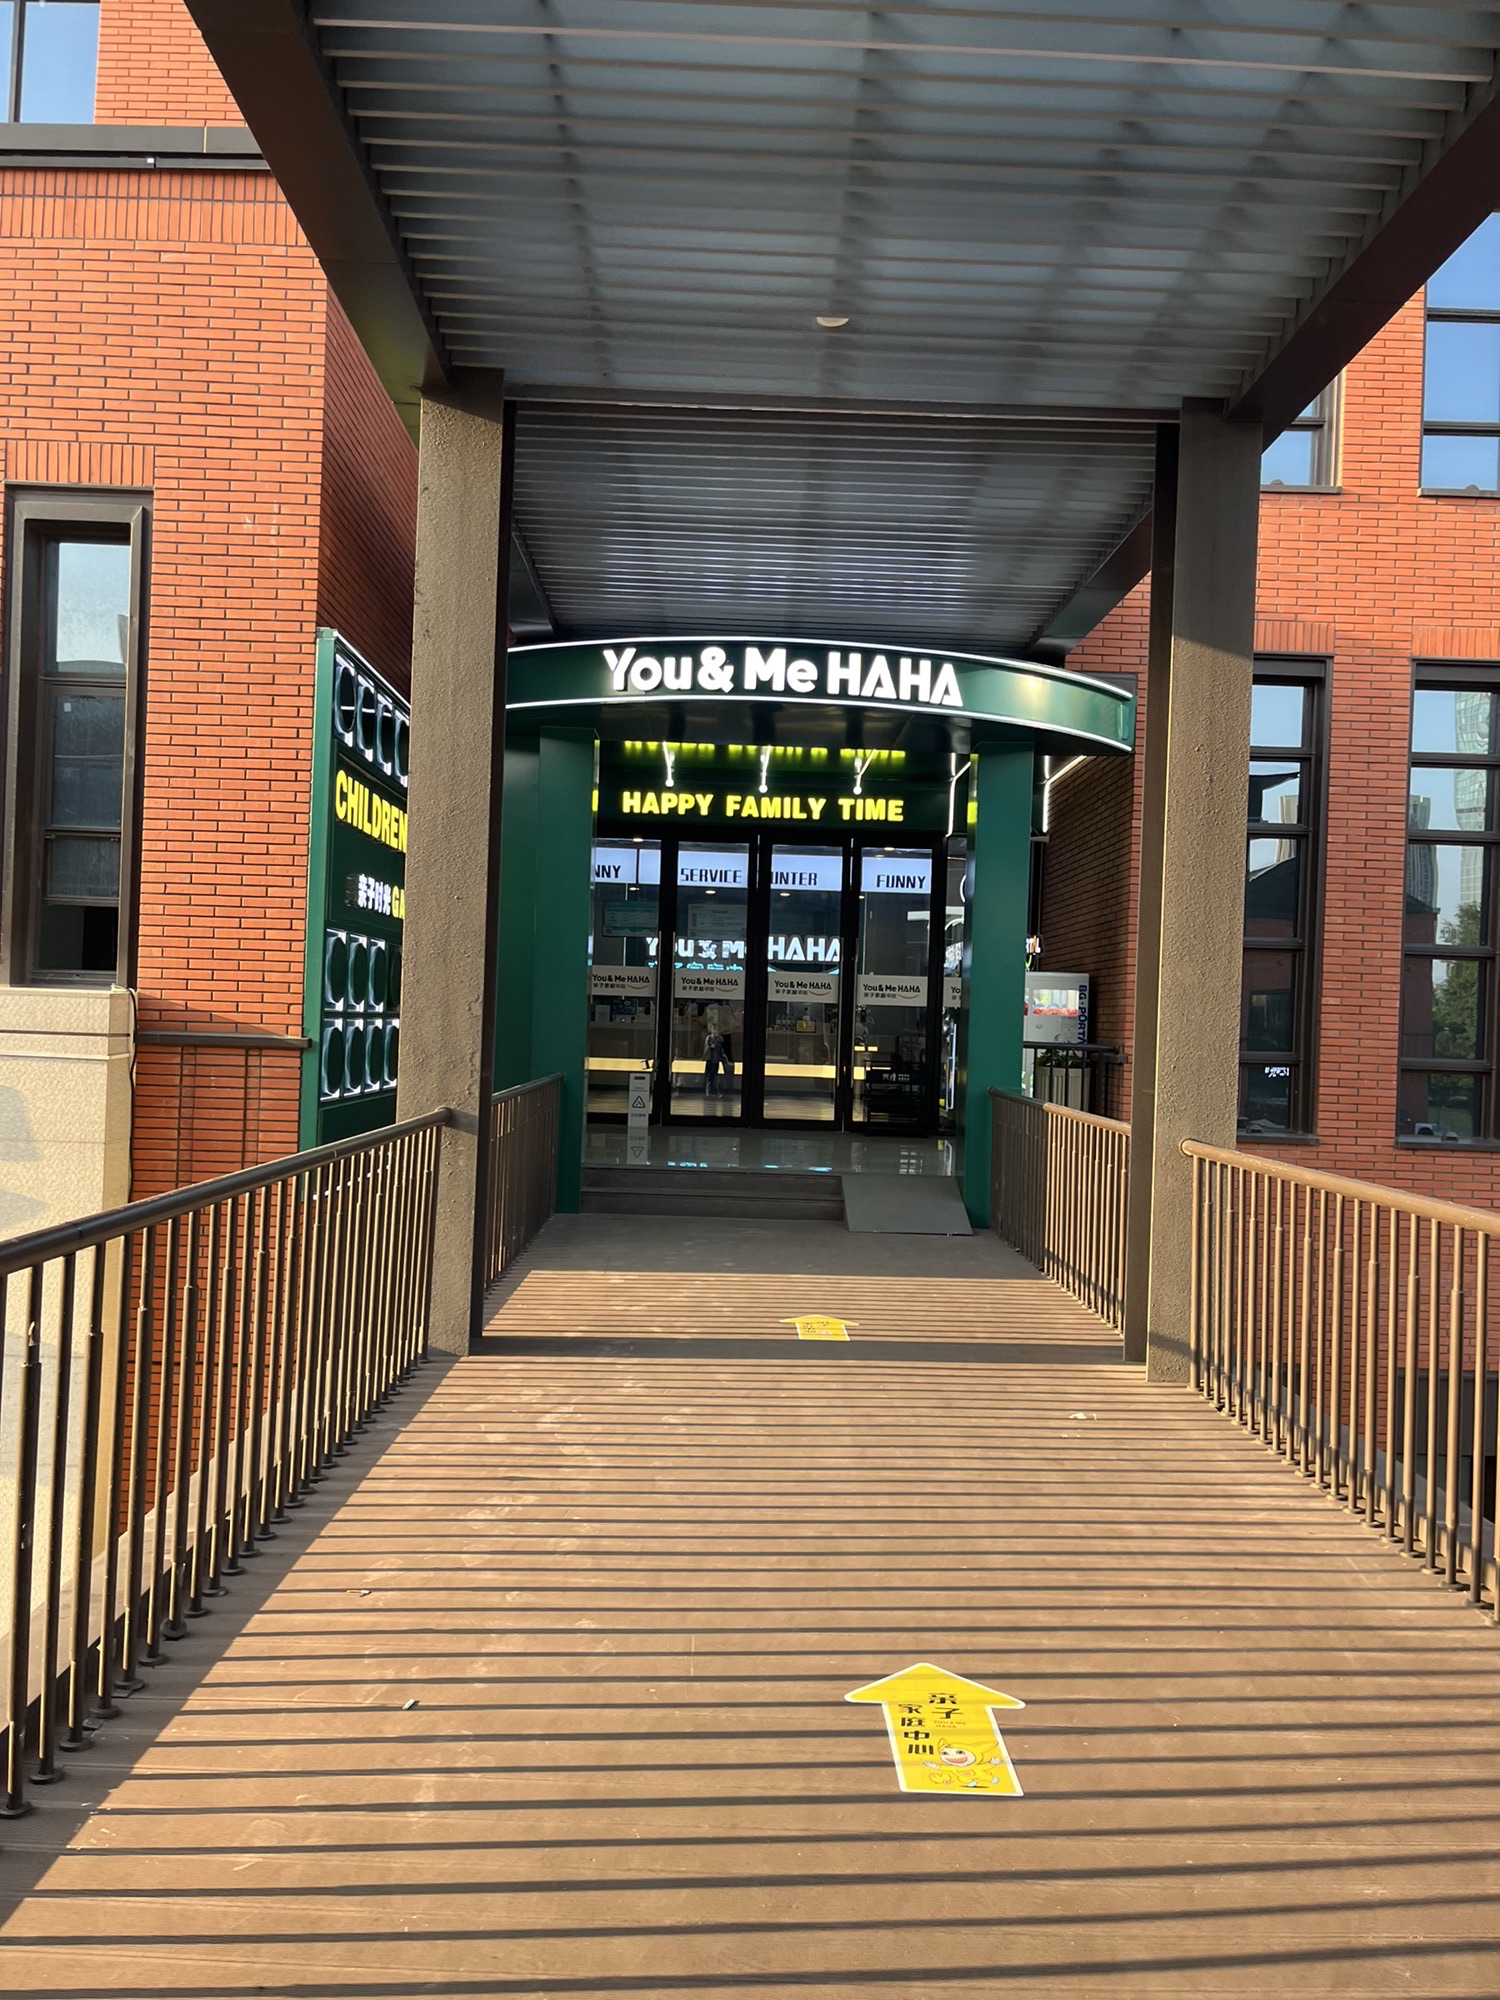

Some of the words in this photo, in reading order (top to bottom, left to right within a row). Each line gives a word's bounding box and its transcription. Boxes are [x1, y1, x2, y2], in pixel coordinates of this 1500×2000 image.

[827, 650, 964, 707] HAHA
[335, 769, 409, 854] CHILDREN
[622, 791, 714, 817] HAPPY
[725, 795, 827, 821] FAMILY
[837, 798, 905, 823] TIME
[680, 867, 742, 884] SERVICE
[876, 874, 927, 889] FUNNY
[721, 940, 747, 960] M
[768, 936, 841, 962] HAHA
[627, 976, 650, 984] HAHA
[715, 978, 739, 987] HAHA
[809, 982, 832, 990] HAHA
[898, 985, 921, 993] HAHA
